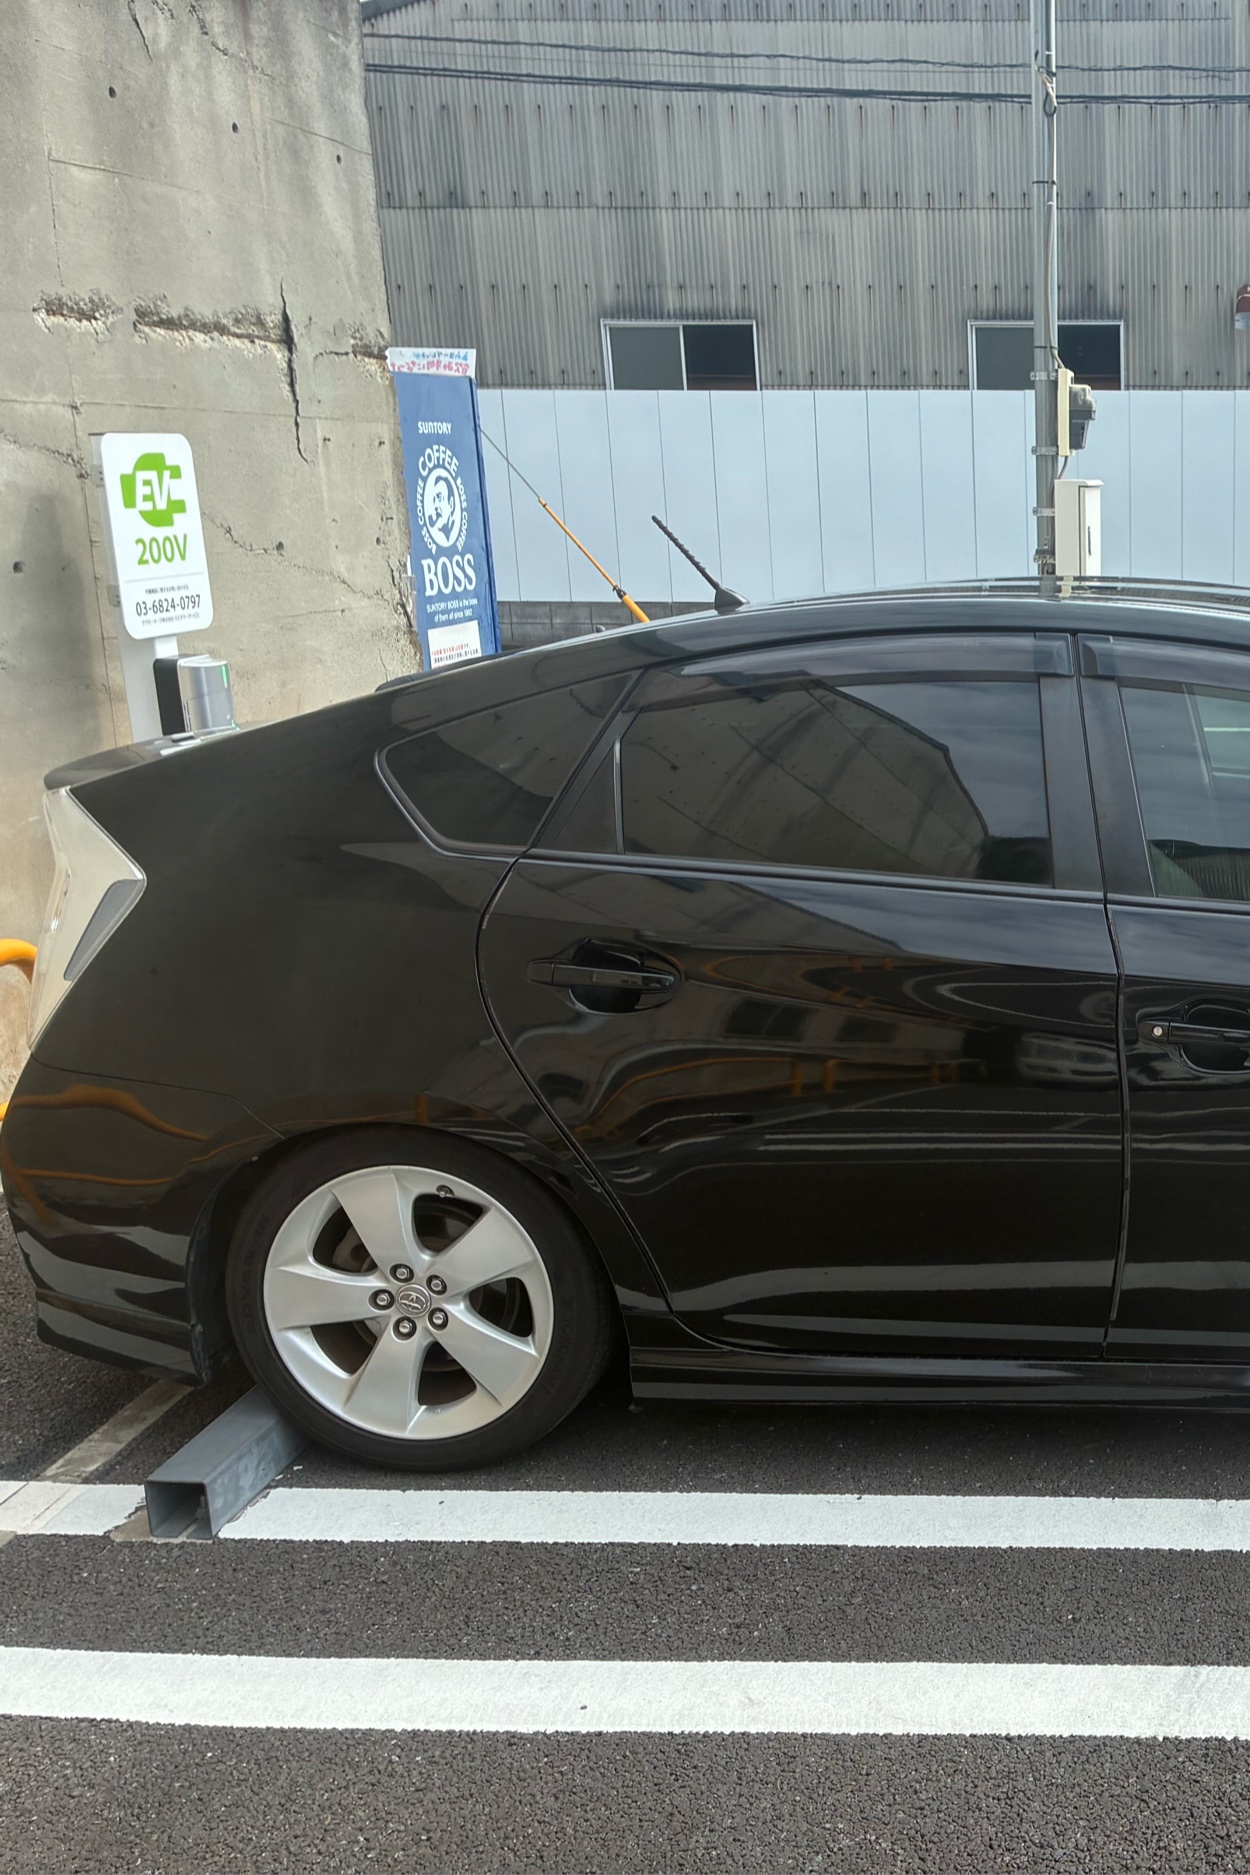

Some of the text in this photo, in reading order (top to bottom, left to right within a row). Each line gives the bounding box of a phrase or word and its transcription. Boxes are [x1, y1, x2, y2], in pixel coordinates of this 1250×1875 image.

[417, 421, 452, 435] SUNTORY
[418, 444, 459, 478] COFFEE
[135, 534, 188, 566] 200V
[421, 553, 477, 597] BOSS
[135, 594, 201, 617] 03-6824-0797
[426, 602, 447, 614] SUNTORY
[447, 599, 460, 610] BOSS
